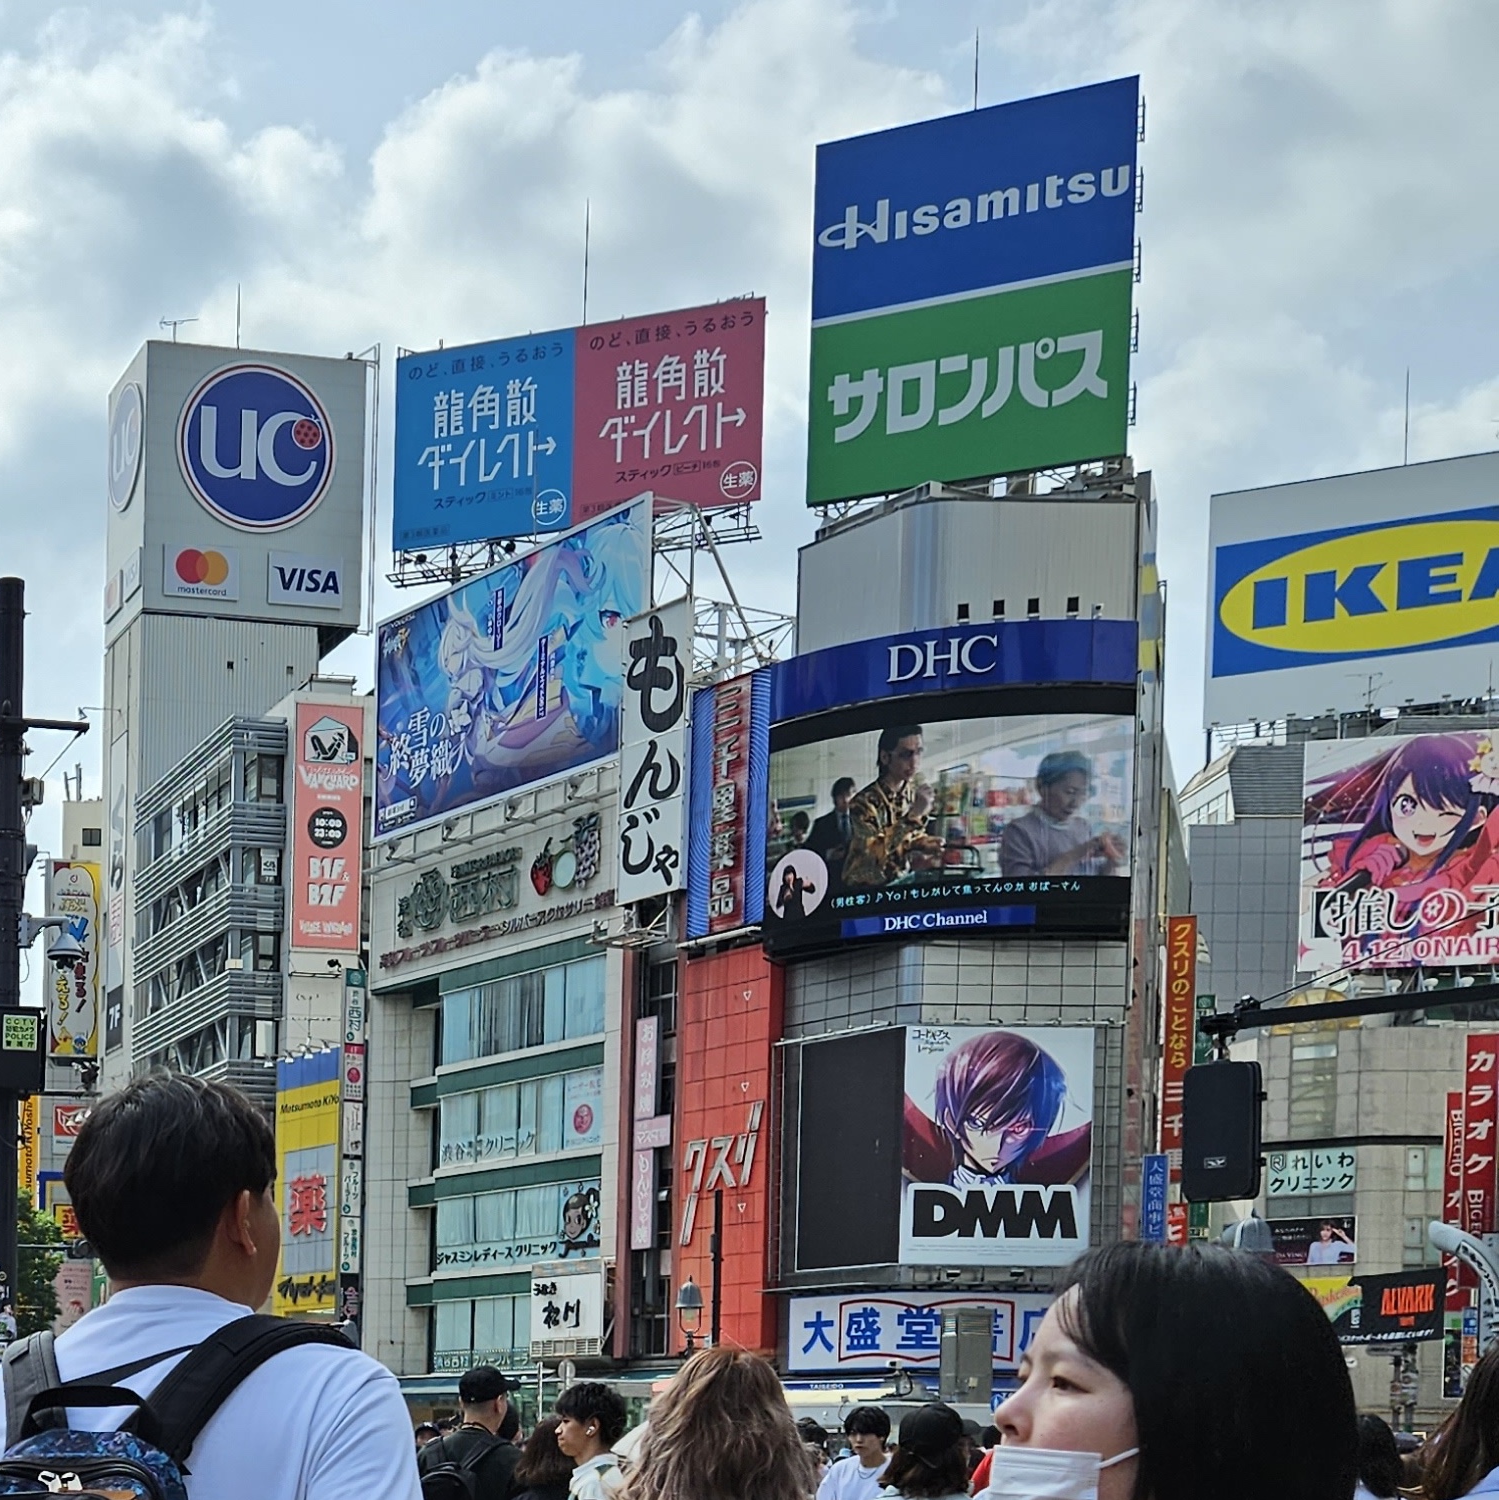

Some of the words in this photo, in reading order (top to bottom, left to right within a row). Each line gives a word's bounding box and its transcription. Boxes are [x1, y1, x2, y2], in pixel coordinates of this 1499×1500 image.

[818, 164, 1131, 250] Hisamitsu
[589, 311, 755, 352] のど、直接、うるおう
[408, 342, 565, 381] のど、直接、うるおう
[616, 346, 728, 411] 龍角散
[827, 329, 1109, 444] サロンパス
[433, 375, 538, 439] 龍角散
[200, 404, 318, 487] UC
[615, 463, 672, 483] スティック
[722, 468, 755, 491] 生薬
[433, 491, 487, 510] スティック
[535, 494, 565, 518] 生薬
[177, 584, 227, 597] mastercard
[272, 565, 340, 595] VISA
[885, 634, 999, 684] DHC
[619, 615, 686, 888] もんじゃ
[315, 817, 343, 829] 10:00
[308, 856, 347, 880] B1F
[307, 882, 347, 907] B2F
[883, 914, 921, 932] DHC
[922, 909, 989, 929] Channel
[1168, 920, 1191, 1070] クスリのことなら
[5, 1018, 36, 1026] CCTV
[108, 1003, 121, 1031] 7F
[5, 1032, 35, 1041] POLICE
[279, 1097, 321, 1115] Matsumoto
[1465, 1049, 1496, 1175] カラオケ
[24, 1147, 35, 1193] sumoto
[1291, 1152, 1355, 1171] れいわ
[1269, 1173, 1355, 1193] クリニック
[289, 1174, 328, 1238] 薬
[912, 1189, 1079, 1239] DMM
[436, 1240, 558, 1265] ジャスミンレディースクリニック
[1380, 1283, 1437, 1316] ALVARK
[801, 1306, 1051, 1355] 大盛堂
[809, 1382, 845, 1390] TAISEIDO
